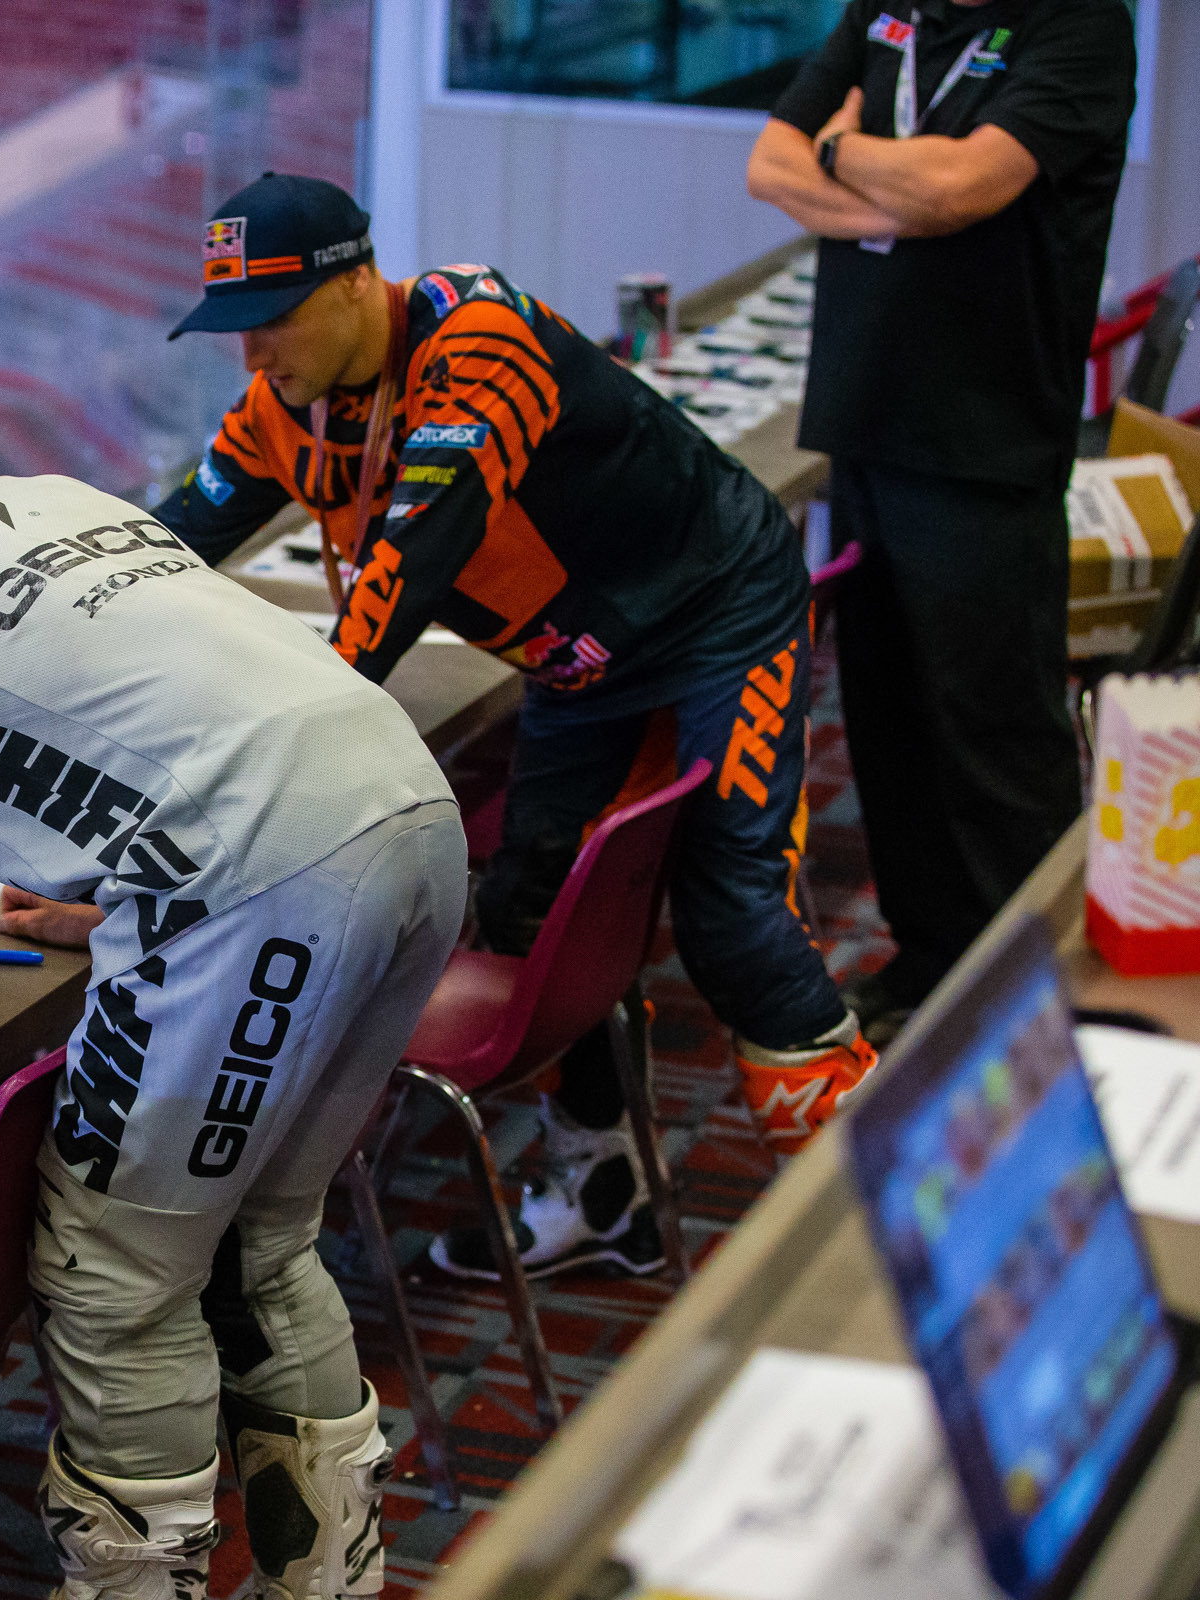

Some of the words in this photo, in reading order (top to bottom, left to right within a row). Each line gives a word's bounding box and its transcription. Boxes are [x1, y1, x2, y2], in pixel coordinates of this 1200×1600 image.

[333, 538, 404, 668] KTM
[717, 640, 798, 808] TH
[187, 937, 313, 1178] GEICO
